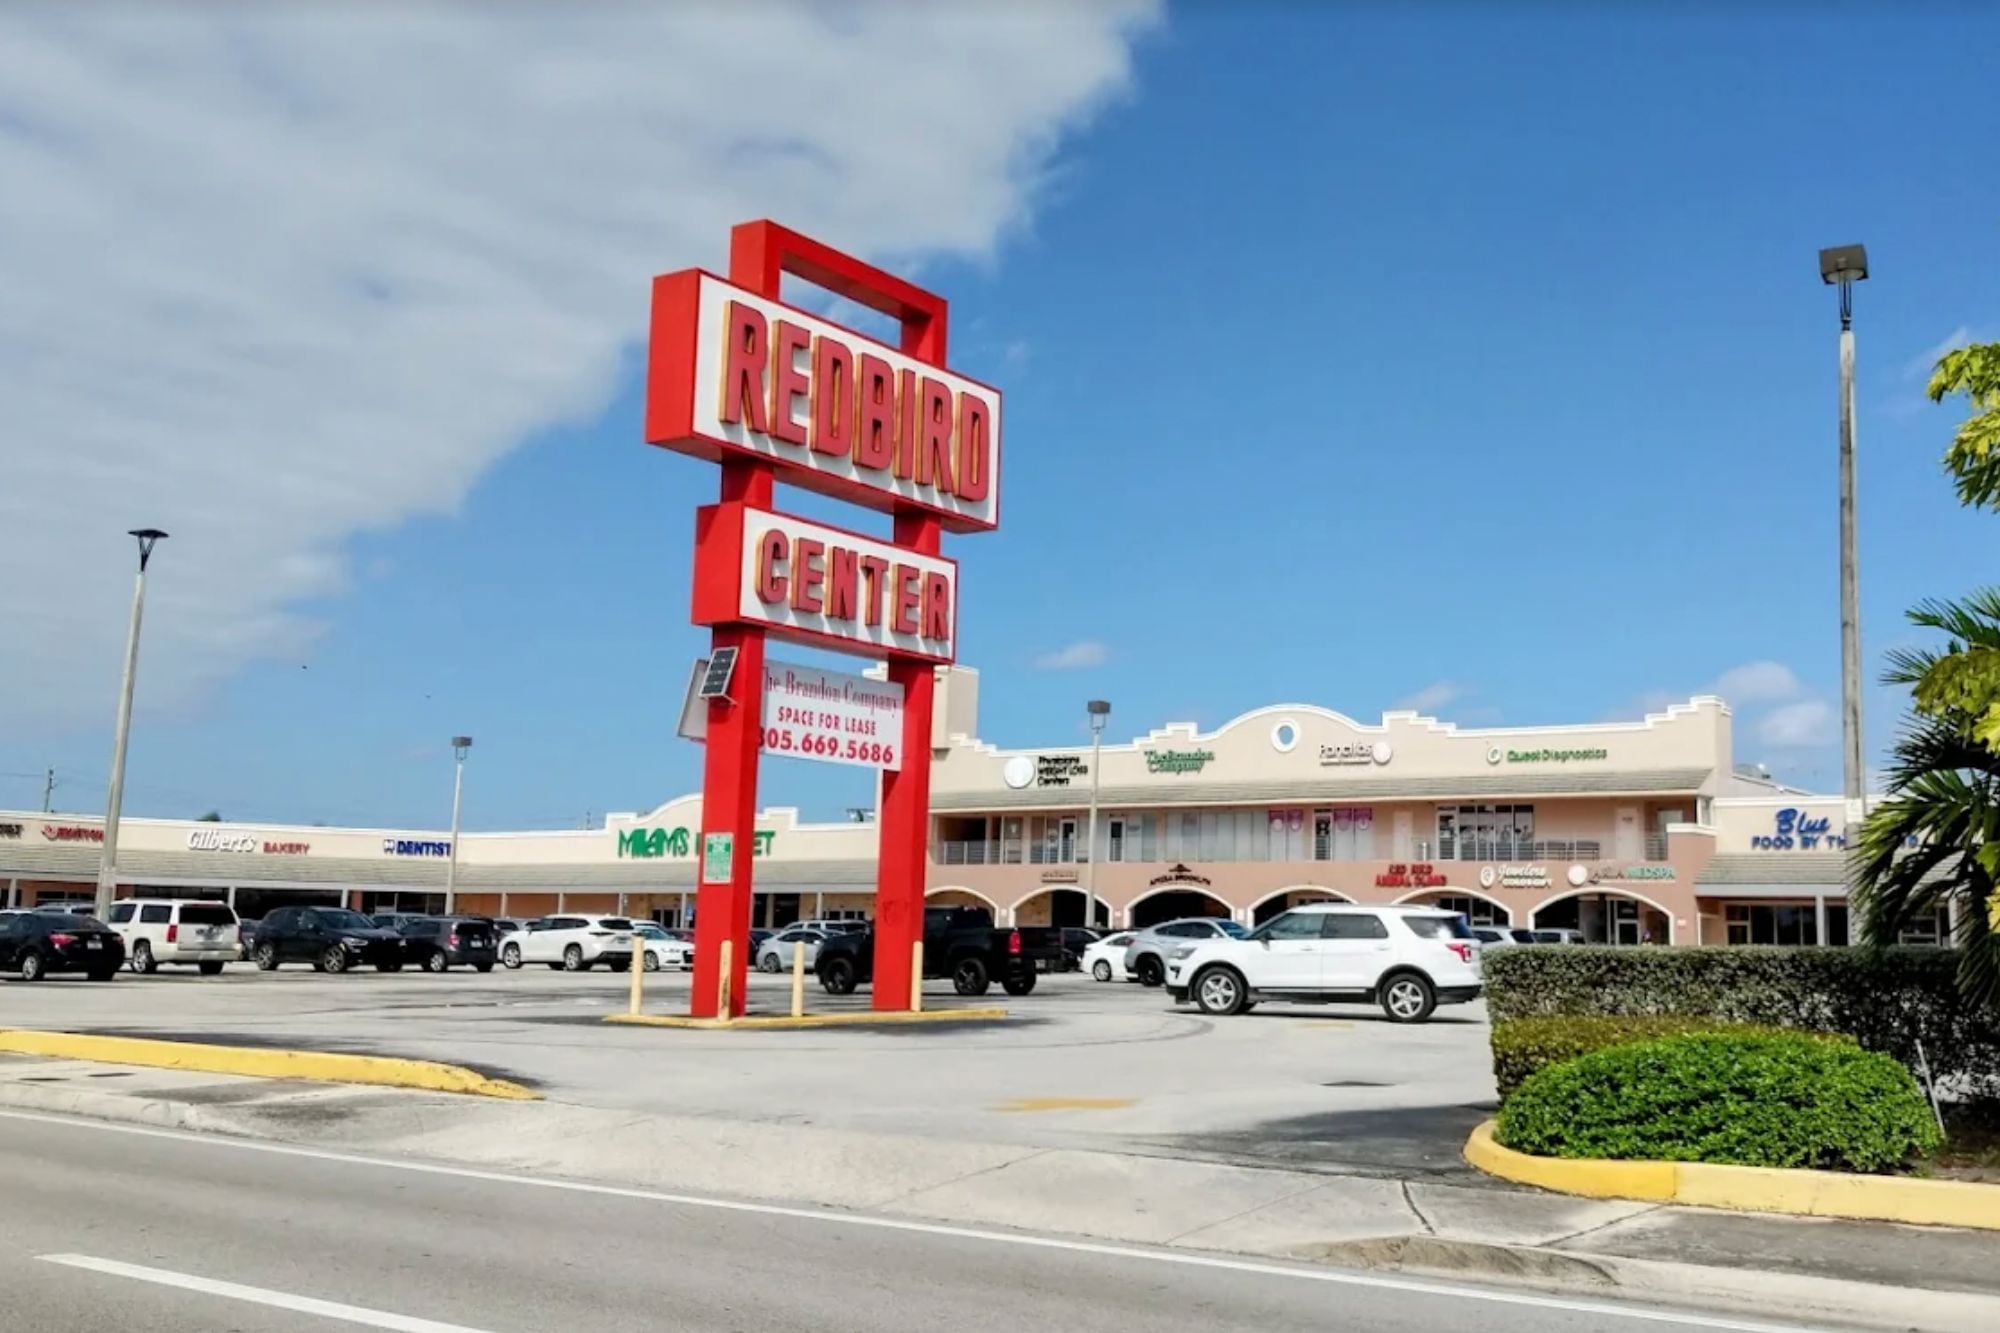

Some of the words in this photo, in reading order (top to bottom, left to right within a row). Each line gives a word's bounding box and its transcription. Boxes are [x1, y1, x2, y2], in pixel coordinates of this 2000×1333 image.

[719, 299, 990, 502] REDBIRD
[755, 528, 949, 641] CENTER
[762, 666, 781, 692] he
[785, 670, 841, 702] Brandon
[844, 681, 898, 715] Company
[778, 706, 814, 727] SPACE
[818, 713, 841, 731] FOR
[845, 717, 877, 736] LEASE
[1507, 750, 1541, 762] Quest
[1542, 747, 1608, 763] Diagnostics
[1775, 807, 1830, 835] Blue
[187, 830, 257, 853] Gilbert's
[263, 841, 310, 855] BAKERY
[396, 840, 452, 857] DENTIST
[1752, 835, 1794, 850] FOOD
[1801, 836, 1819, 849] BY
[1826, 834, 1847, 849] TH
